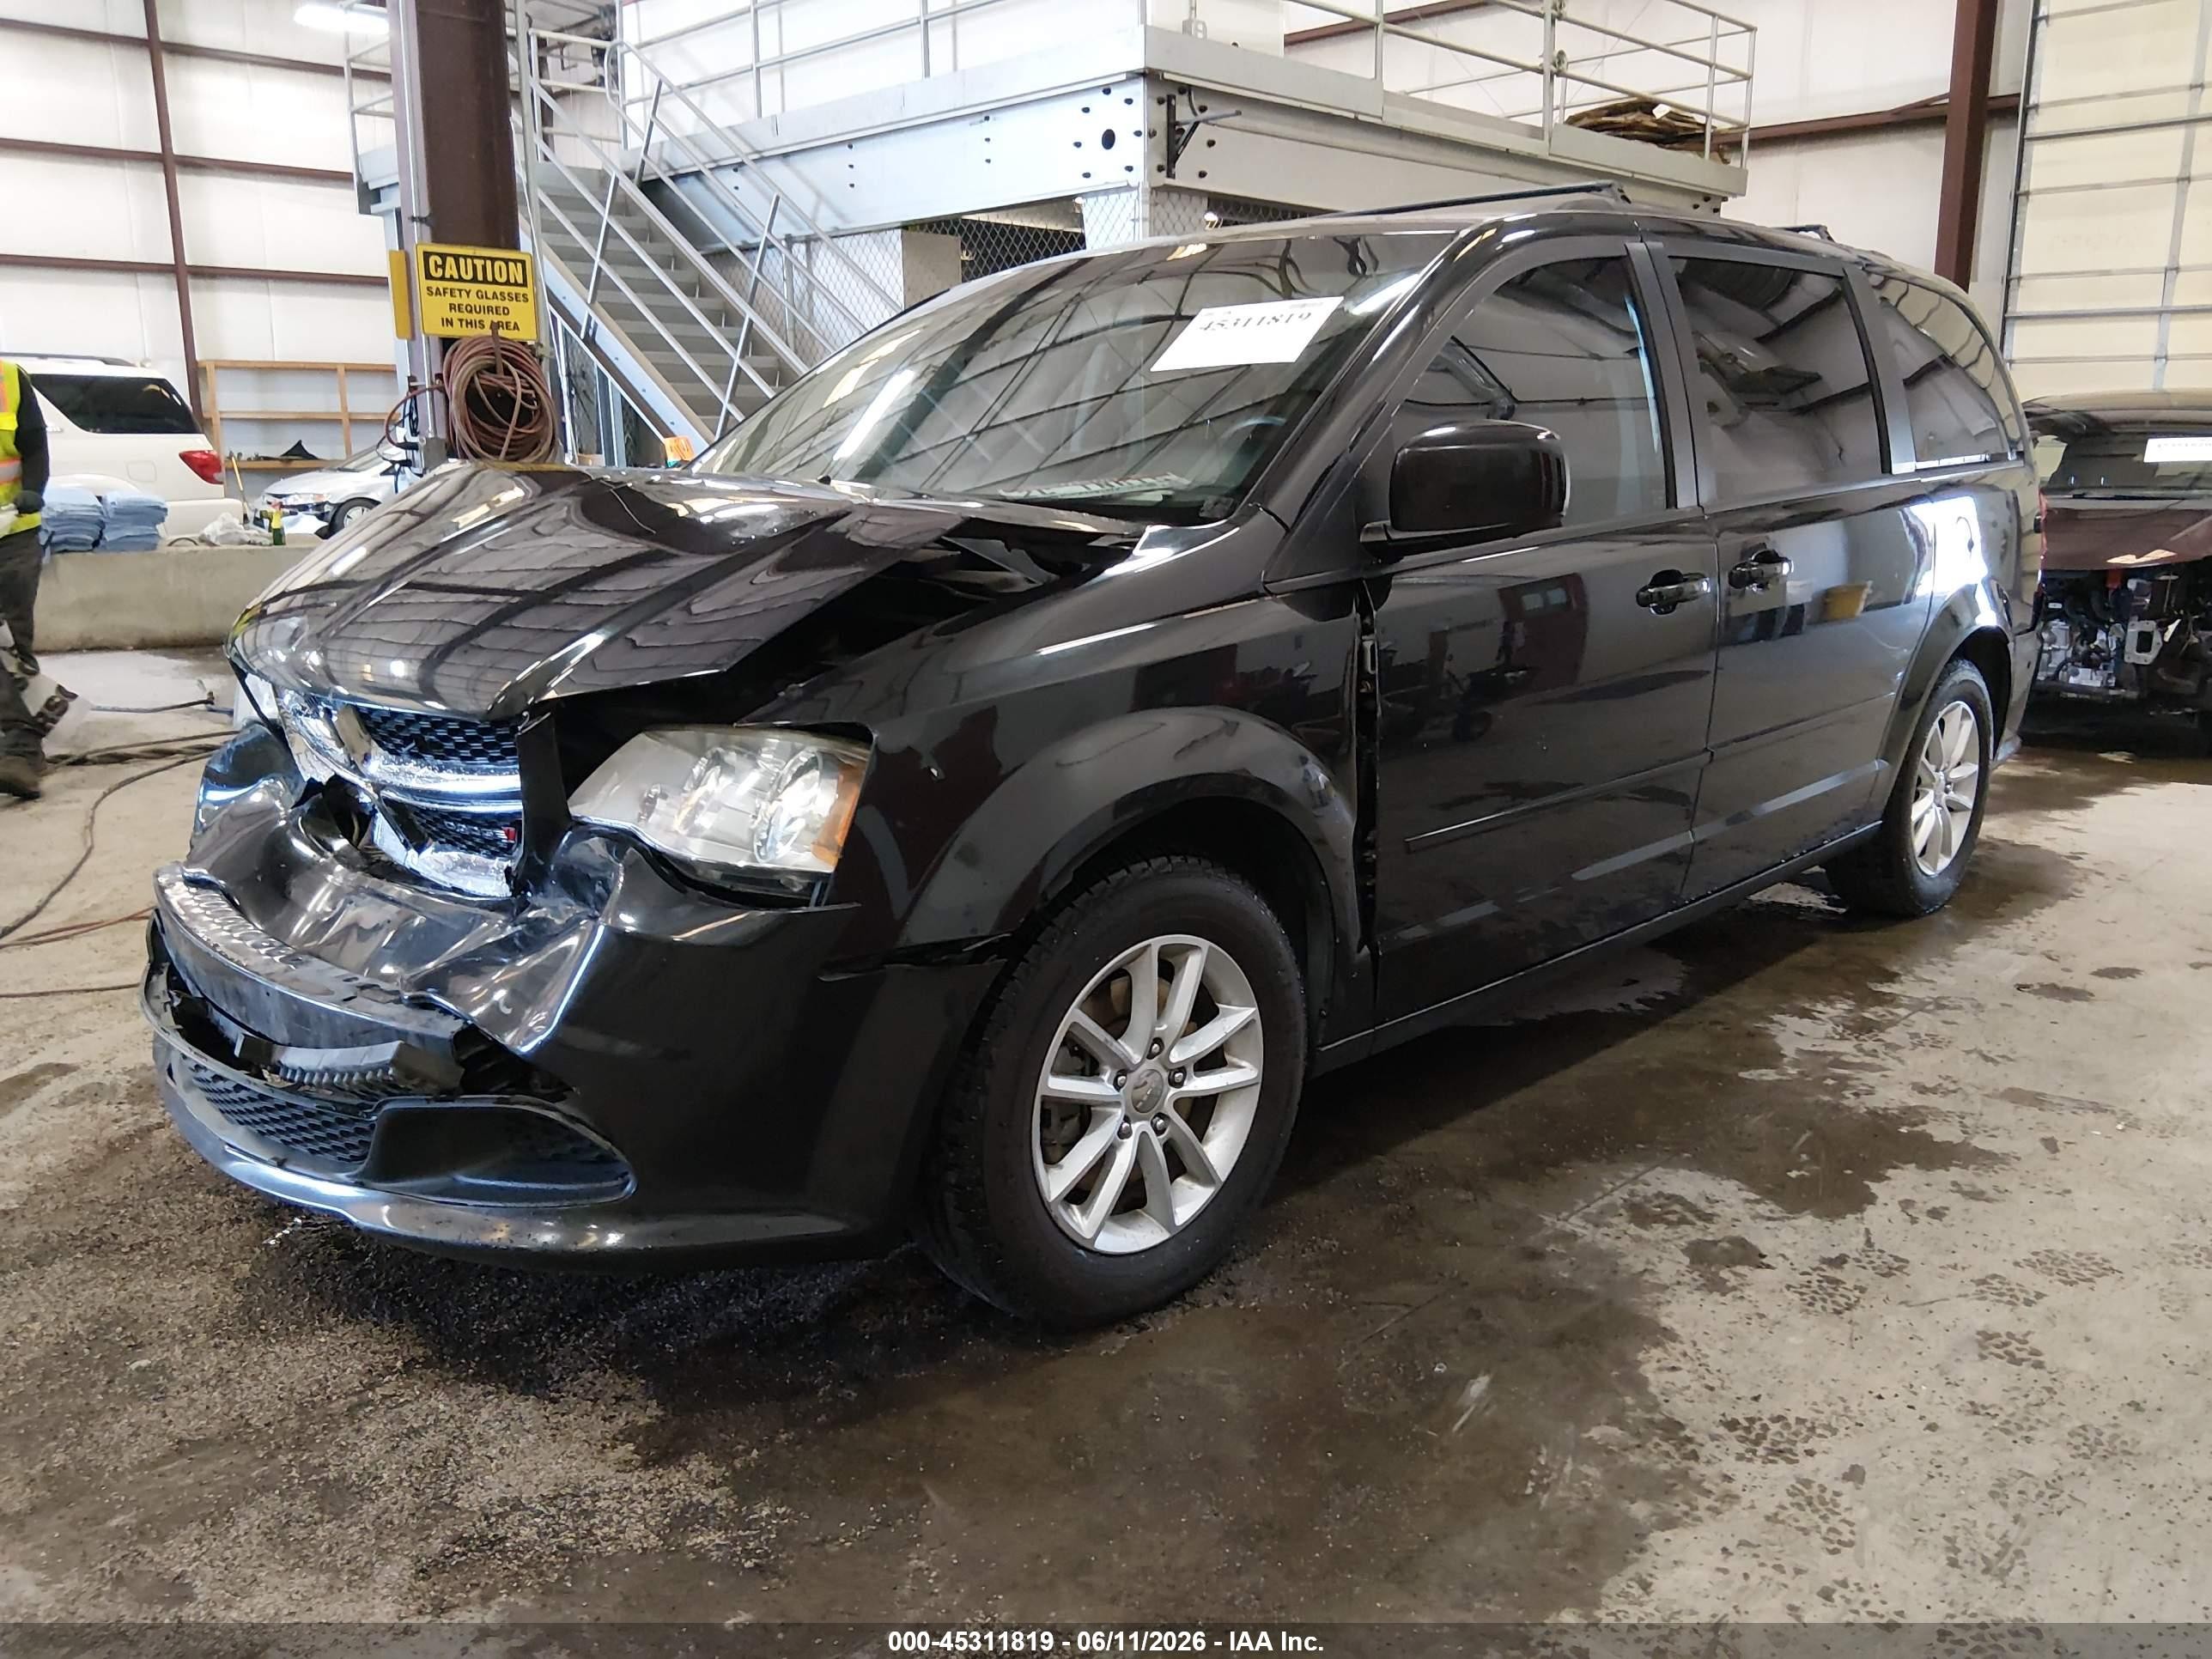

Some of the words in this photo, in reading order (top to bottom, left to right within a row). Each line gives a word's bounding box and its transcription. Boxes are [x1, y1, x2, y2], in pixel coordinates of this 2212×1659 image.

[428, 255, 523, 283] CAUTION
[426, 286, 472, 299] SAFETY
[476, 289, 529, 303] GLASSES
[449, 303, 510, 315] REQUIRED
[441, 318, 454, 328] IN
[458, 319, 485, 330] THIS
